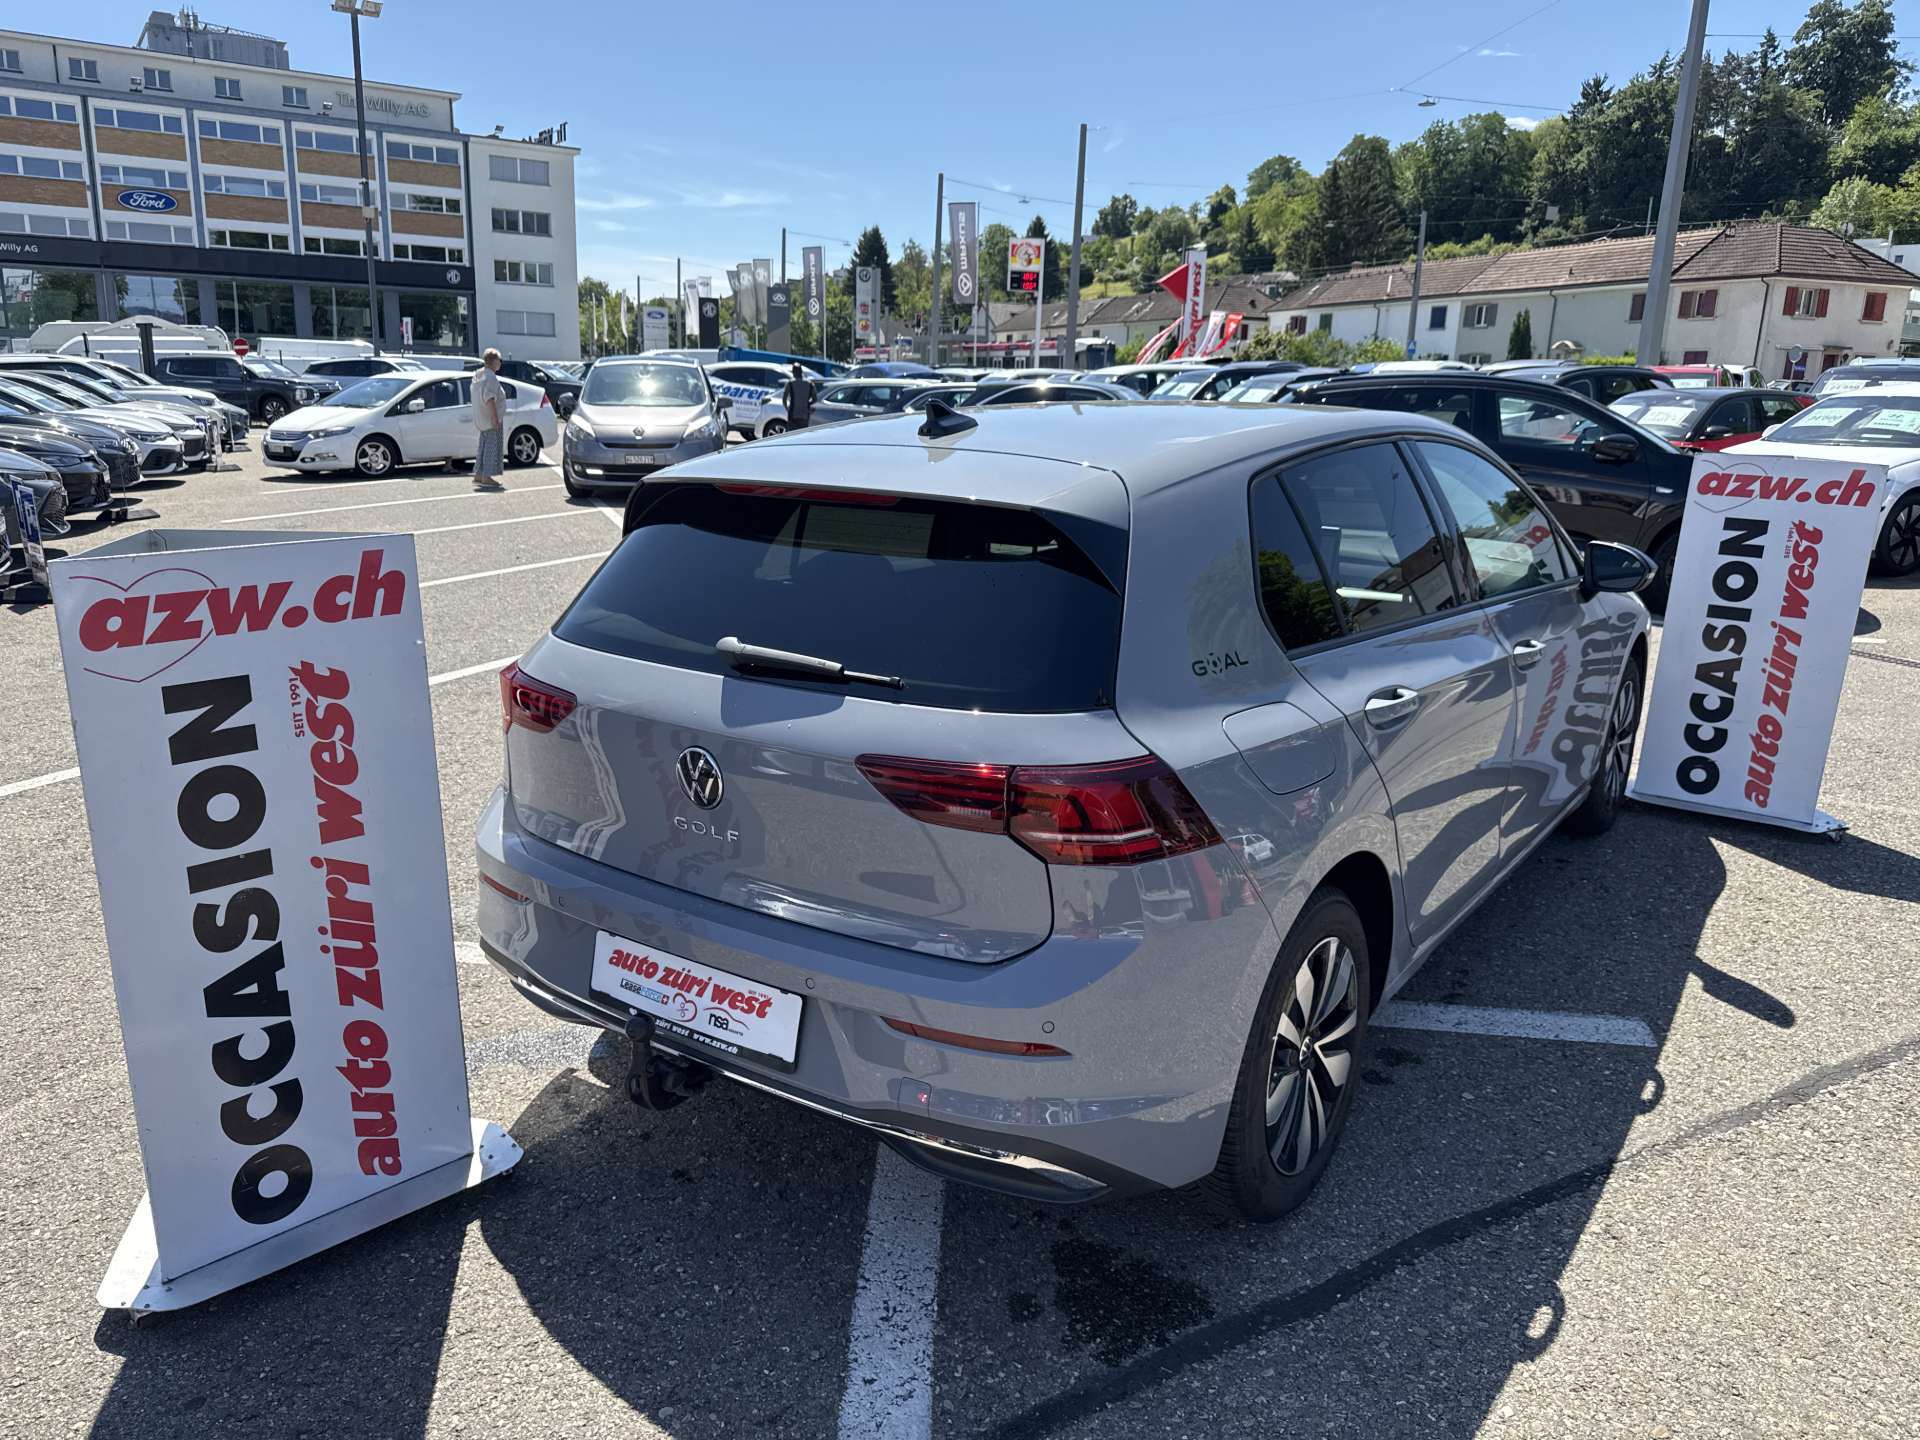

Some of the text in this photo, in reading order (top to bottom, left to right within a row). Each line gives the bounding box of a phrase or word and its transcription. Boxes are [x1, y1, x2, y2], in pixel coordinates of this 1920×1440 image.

[366, 95, 403, 118] Willy
[405, 103, 431, 118] AG
[130, 192, 166, 209] Ford
[23, 243, 39, 254] AG
[1697, 469, 1875, 507] azw.ch
[79, 550, 406, 651] azw.ch
[1676, 517, 1769, 795] OCCASION
[1744, 520, 1823, 808] auto züri west
[288, 676, 306, 739] SEIT 1991
[676, 745, 724, 810] VW
[673, 816, 740, 843] GOLF
[161, 674, 312, 1225] OCCASION
[289, 660, 401, 1177] auto züri west
[608, 949, 773, 1019] auto züri west
[655, 1018, 671, 1031] züri
[672, 1024, 690, 1037] west
[692, 1032, 739, 1054] www.azw.ch
[708, 1013, 729, 1031] nsa
